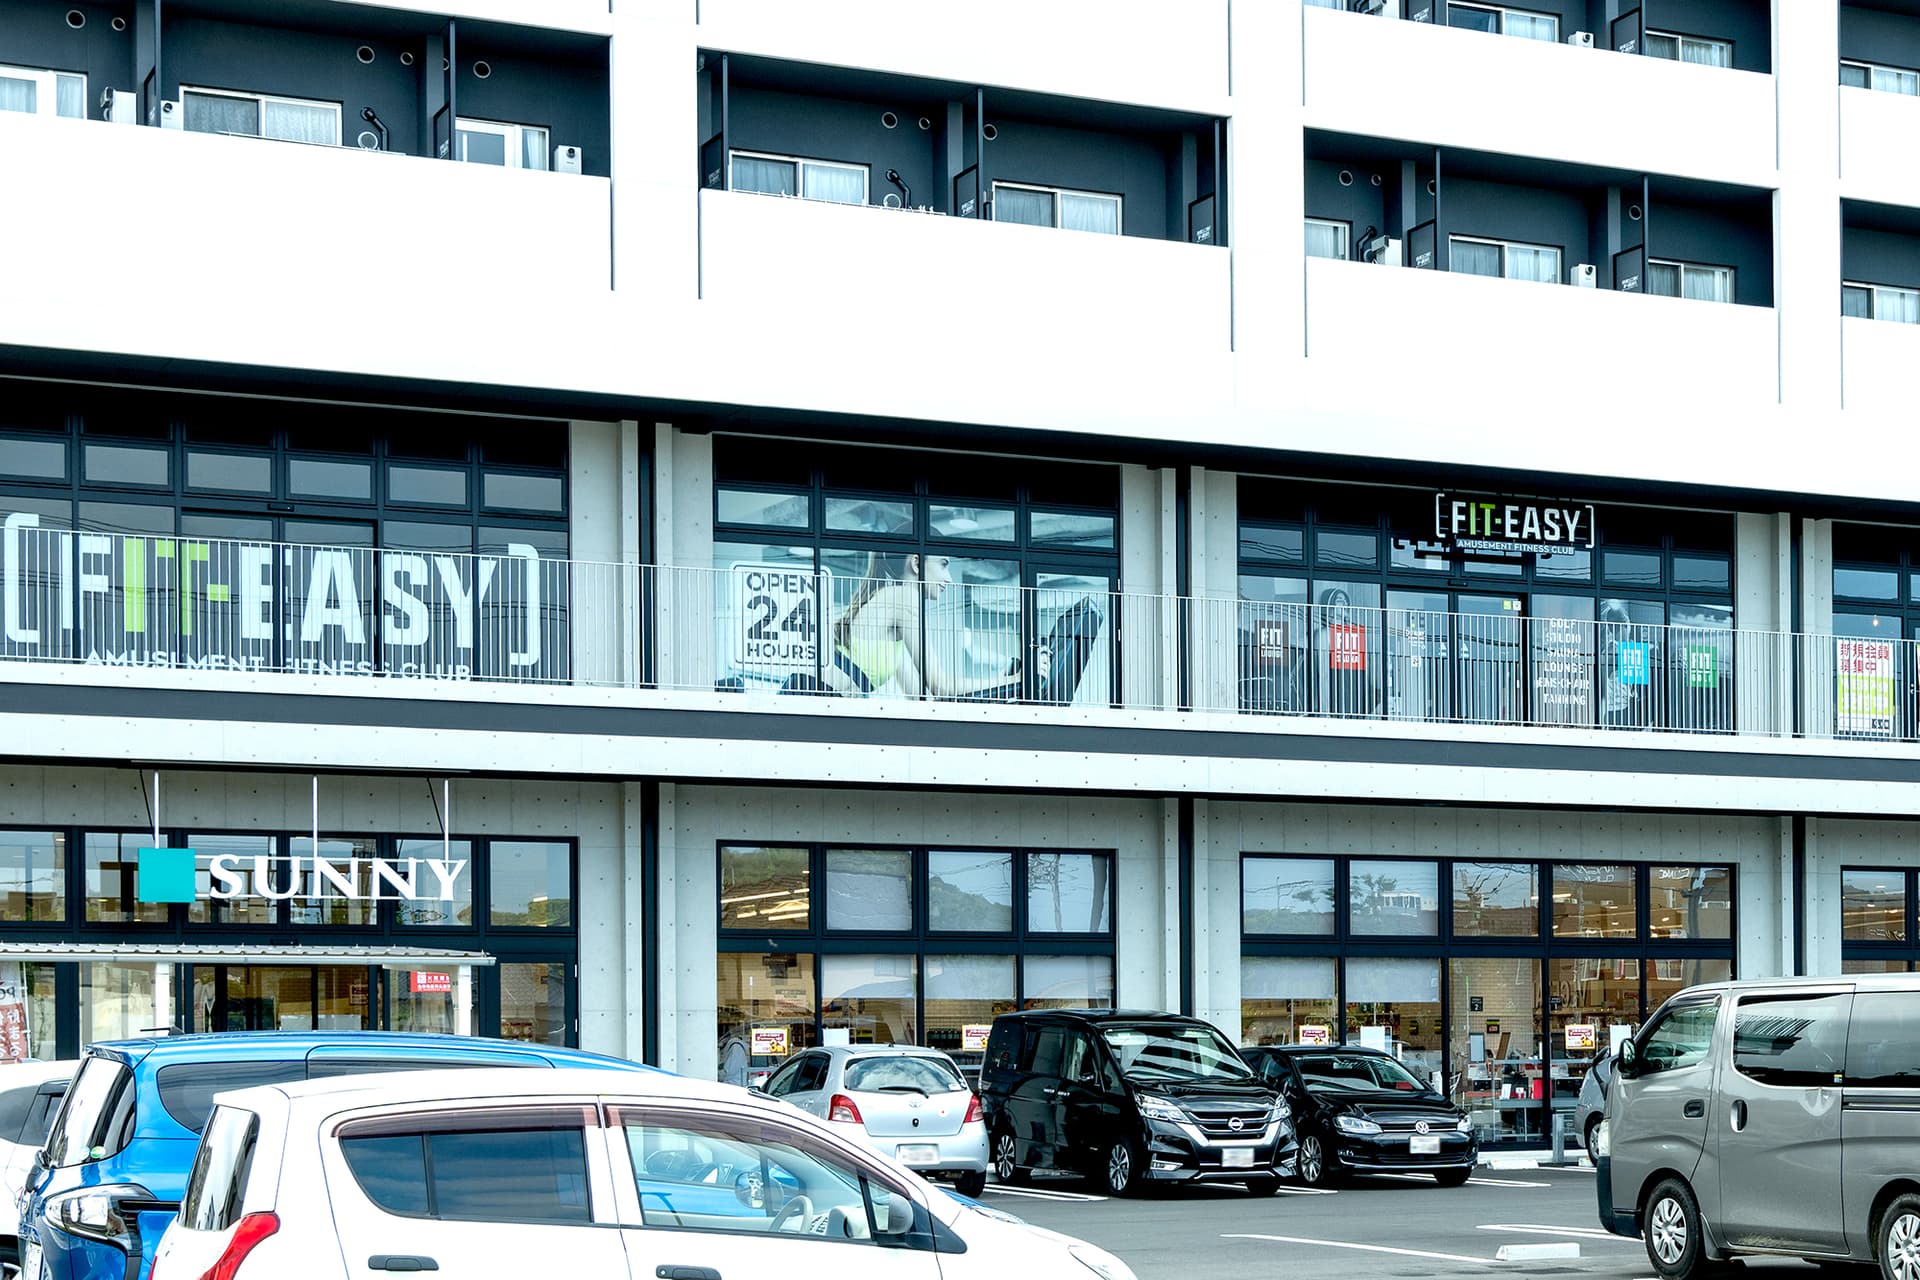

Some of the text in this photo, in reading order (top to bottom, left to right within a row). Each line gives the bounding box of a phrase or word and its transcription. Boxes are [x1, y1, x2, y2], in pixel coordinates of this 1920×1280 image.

[1456, 538, 1575, 555] AMUSEMENT FITNESS CLUB
[746, 571, 816, 594] OPEN
[747, 595, 816, 641] 24
[746, 643, 816, 660] HOURS
[209, 853, 468, 901] SUNNY
